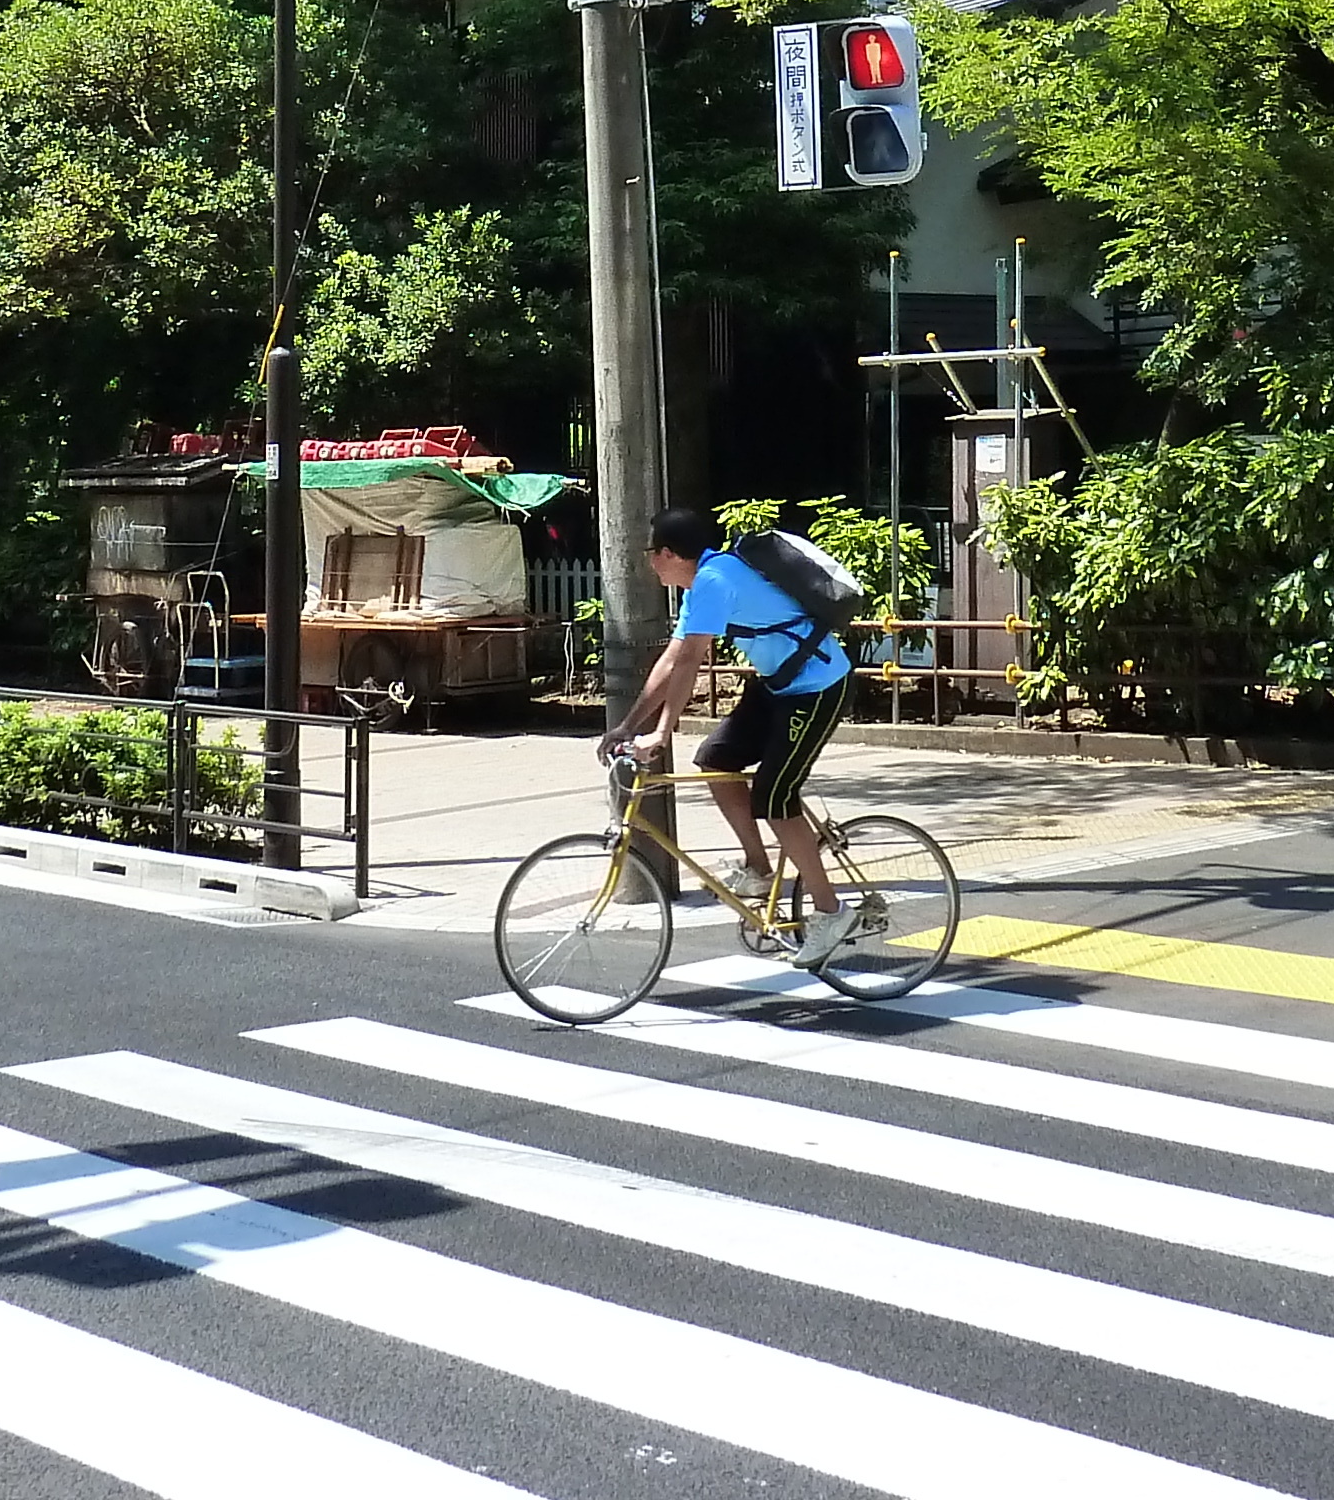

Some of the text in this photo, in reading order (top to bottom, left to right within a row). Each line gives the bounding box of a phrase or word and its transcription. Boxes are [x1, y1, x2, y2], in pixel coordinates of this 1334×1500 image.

[784, 38, 807, 174] 夜間押ボタン式
